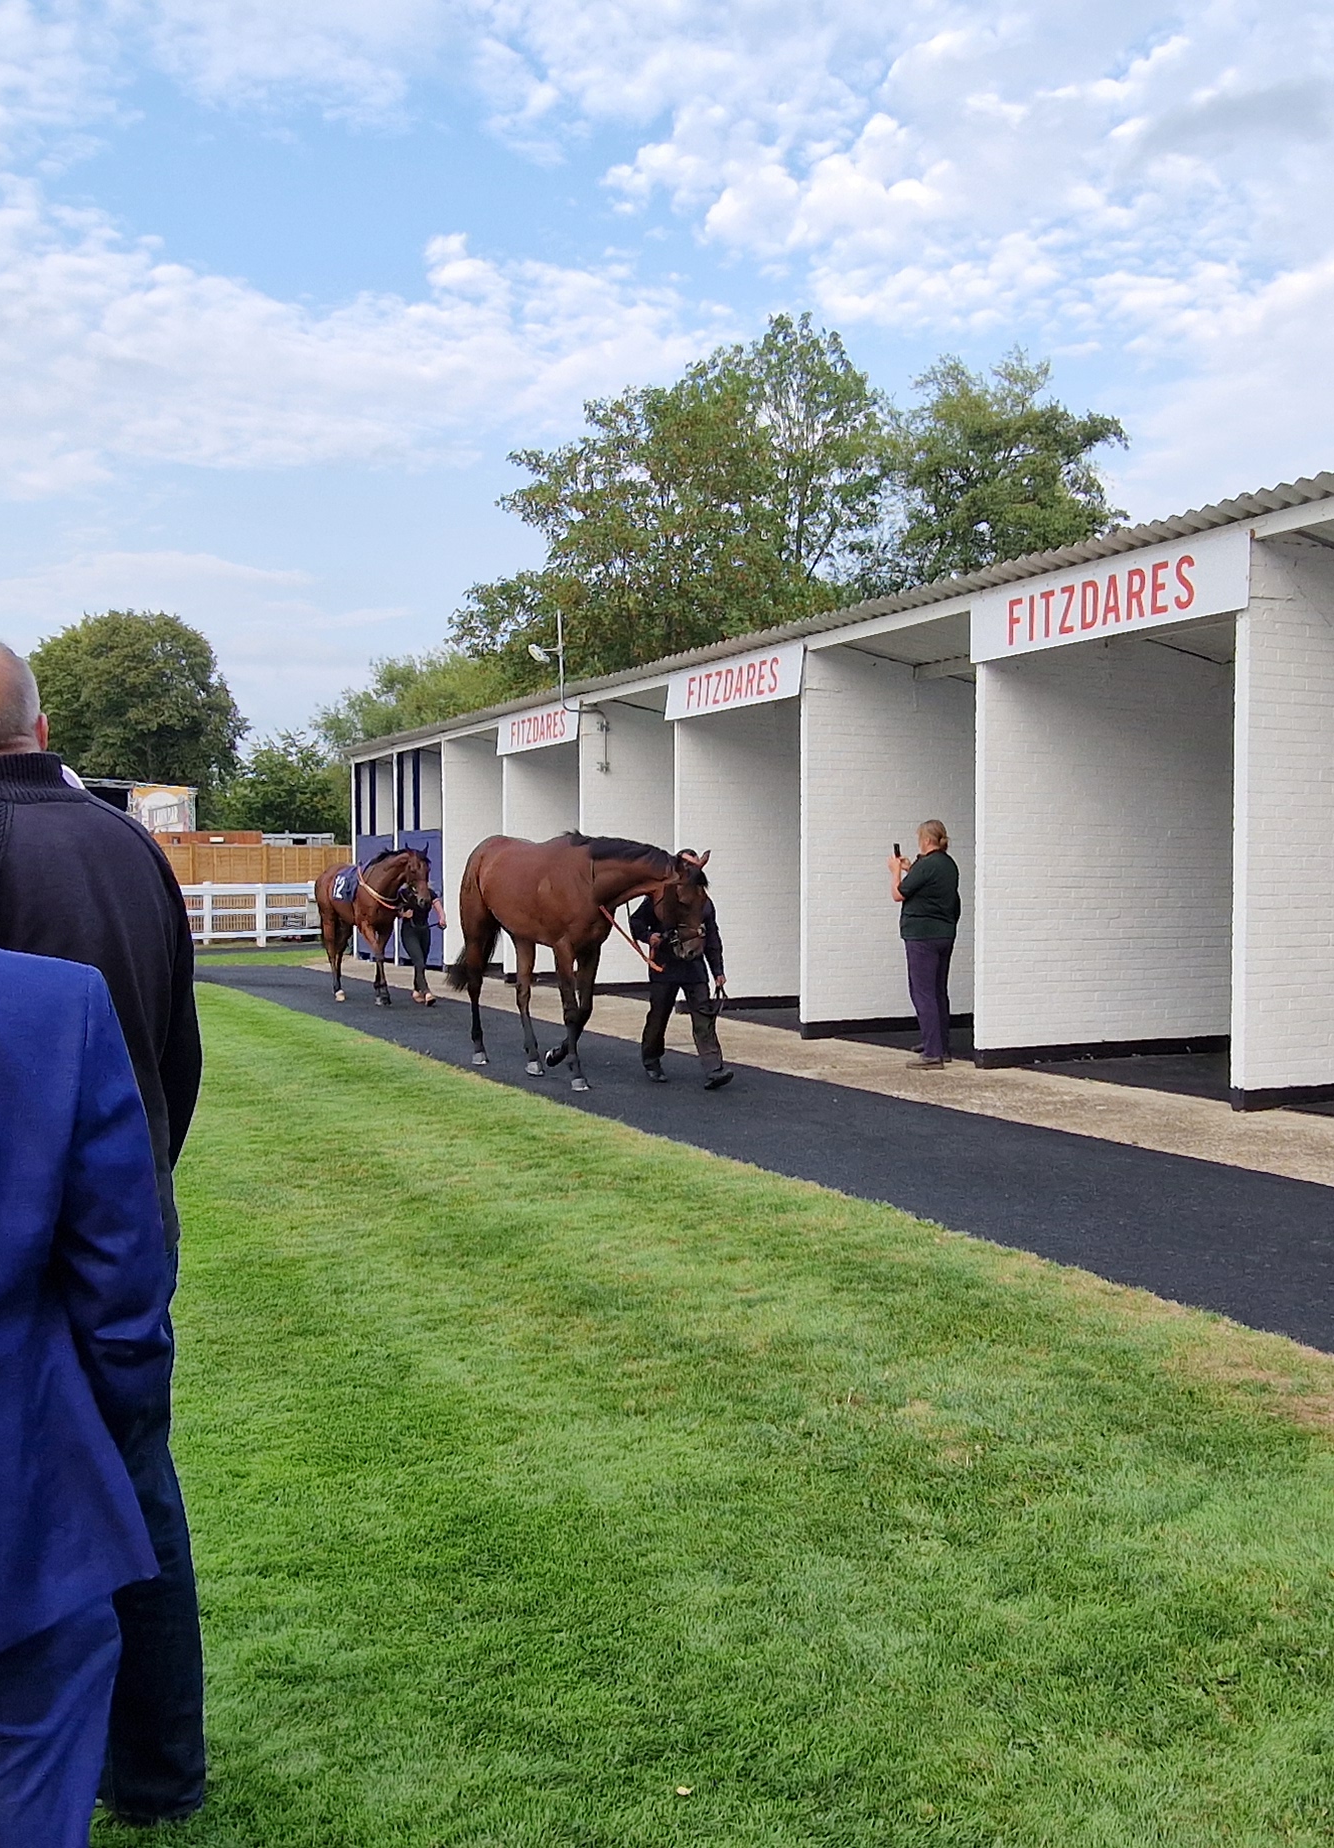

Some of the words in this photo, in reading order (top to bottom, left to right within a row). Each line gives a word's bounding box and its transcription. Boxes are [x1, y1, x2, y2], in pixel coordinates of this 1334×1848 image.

[1007, 554, 1195, 646] FITZDARES
[687, 656, 779, 710] FITZDARES
[510, 709, 566, 748] FITZDARES
